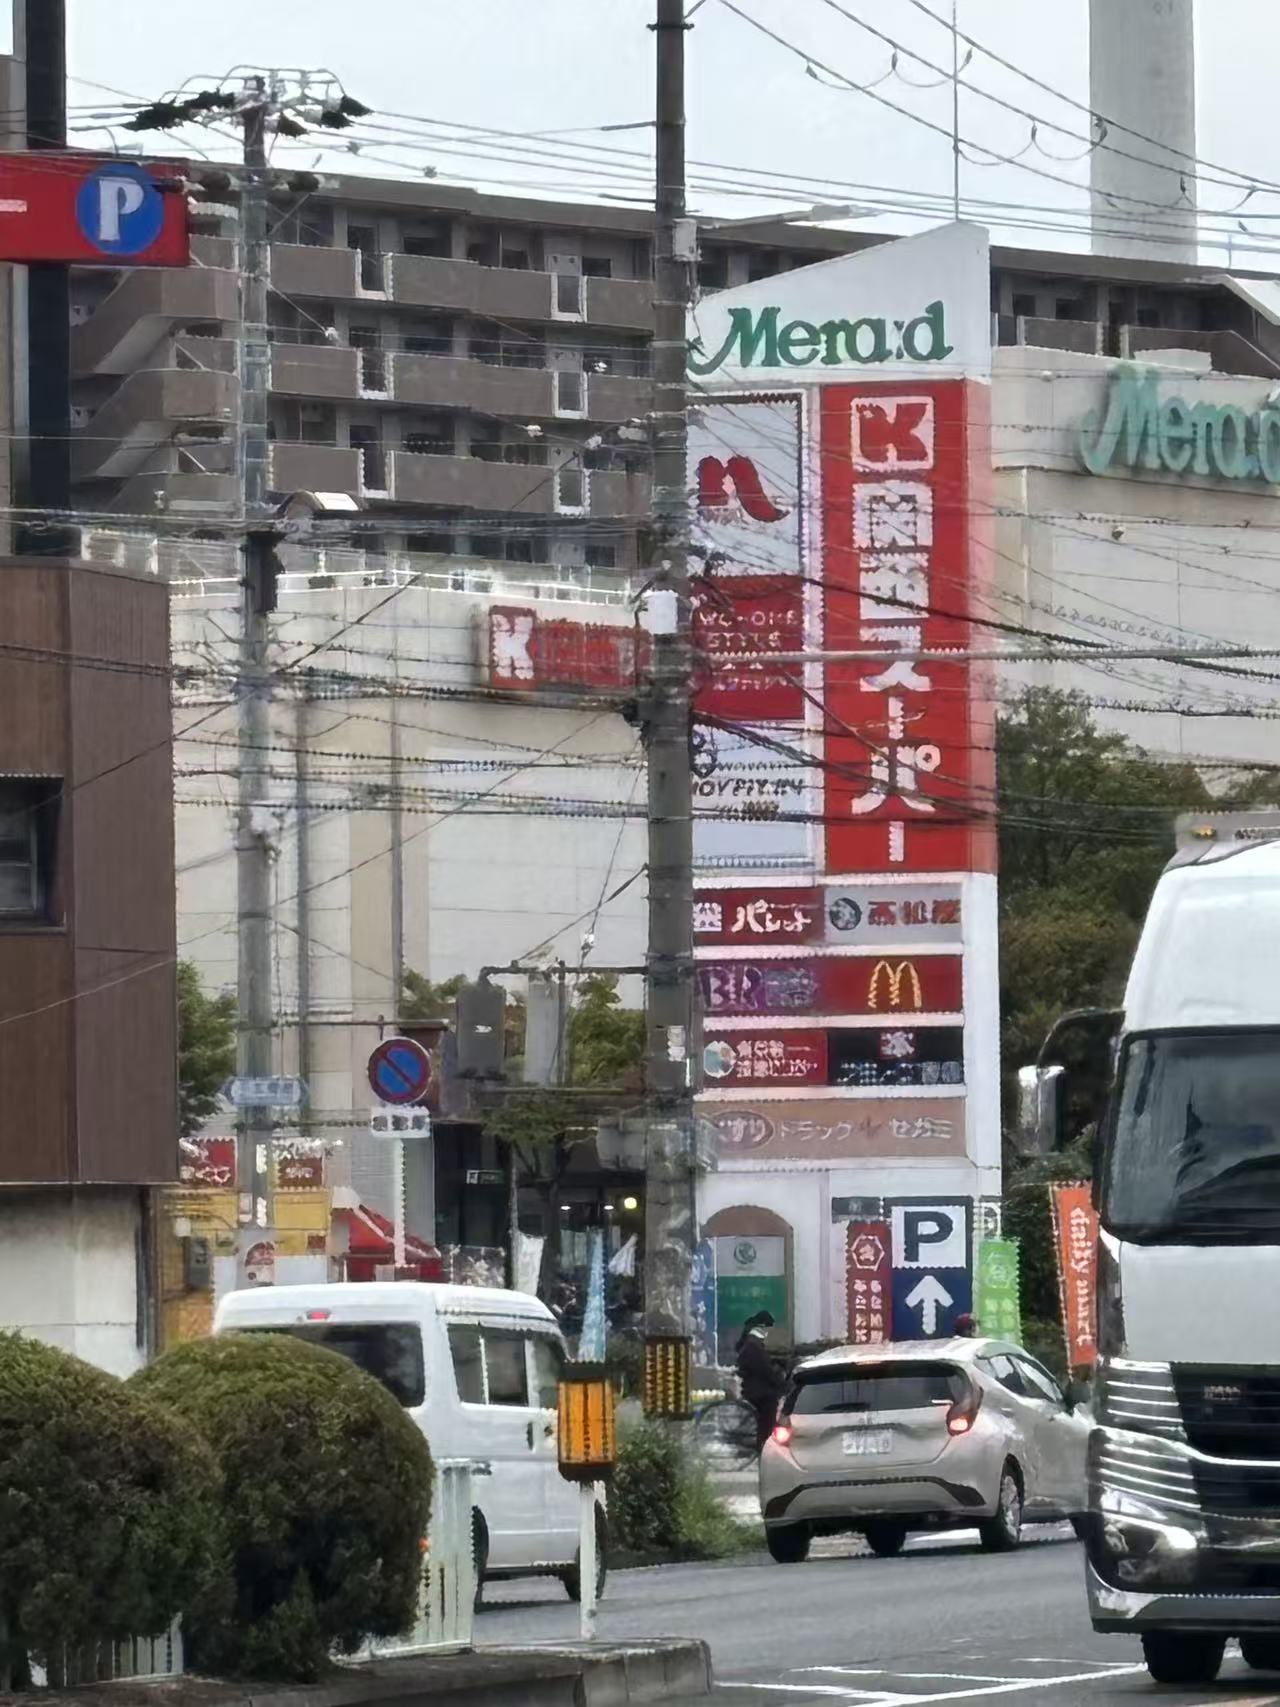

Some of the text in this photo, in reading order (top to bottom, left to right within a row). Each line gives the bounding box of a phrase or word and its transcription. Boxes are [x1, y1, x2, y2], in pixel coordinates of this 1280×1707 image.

[98, 177, 144, 241] P
[492, 614, 534, 680] K
[904, 1211, 954, 1263] P
